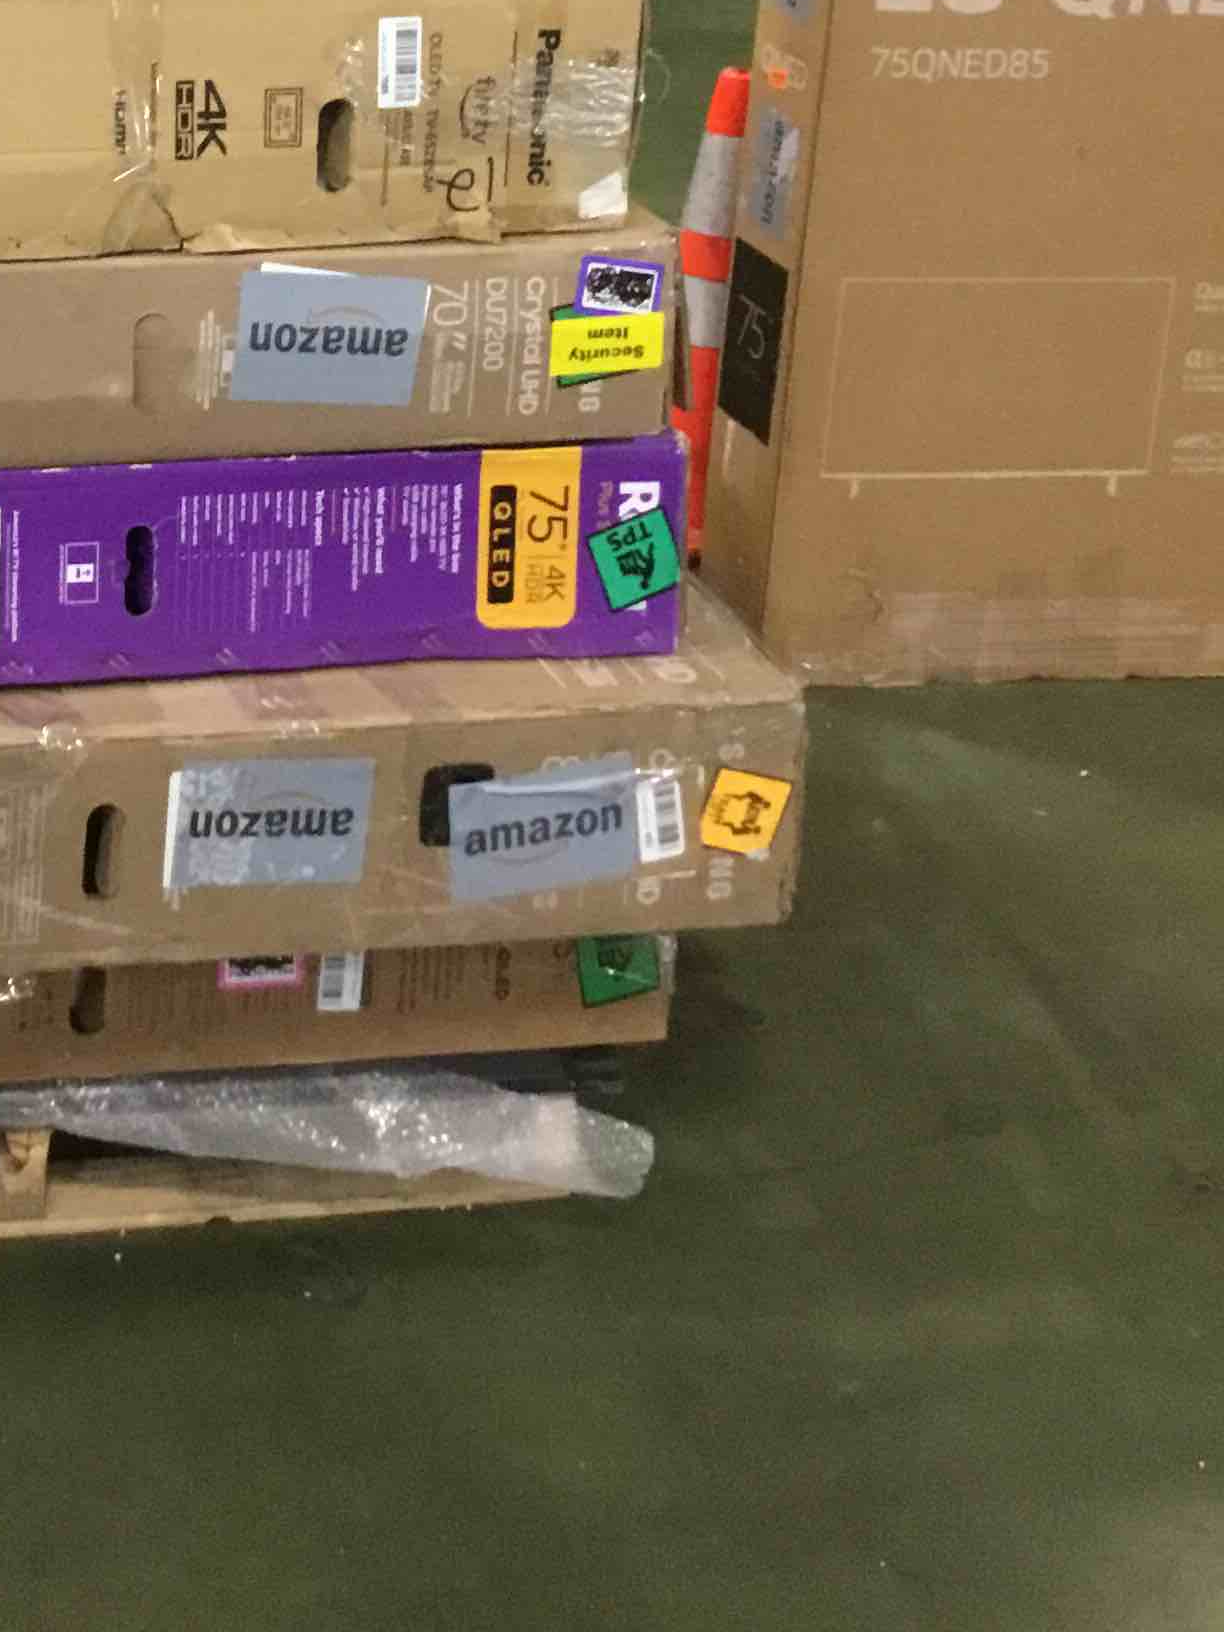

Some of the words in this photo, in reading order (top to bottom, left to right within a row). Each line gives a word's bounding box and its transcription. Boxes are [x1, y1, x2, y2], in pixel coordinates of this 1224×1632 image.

[872, 46, 1050, 81] 75QNED85
[176, 82, 194, 159] HDR
[196, 79, 228, 161] 4K
[249, 319, 410, 357] amazon
[482, 277, 508, 371] DU7200
[519, 276, 546, 365] Crystal
[587, 327, 629, 339] Item
[568, 345, 645, 363] Security
[518, 369, 542, 415] UHD
[492, 500, 511, 588] QLED
[606, 521, 653, 553] TPS
[545, 564, 567, 601] 4K
[189, 806, 354, 843] amazon
[464, 802, 625, 858] amazon
